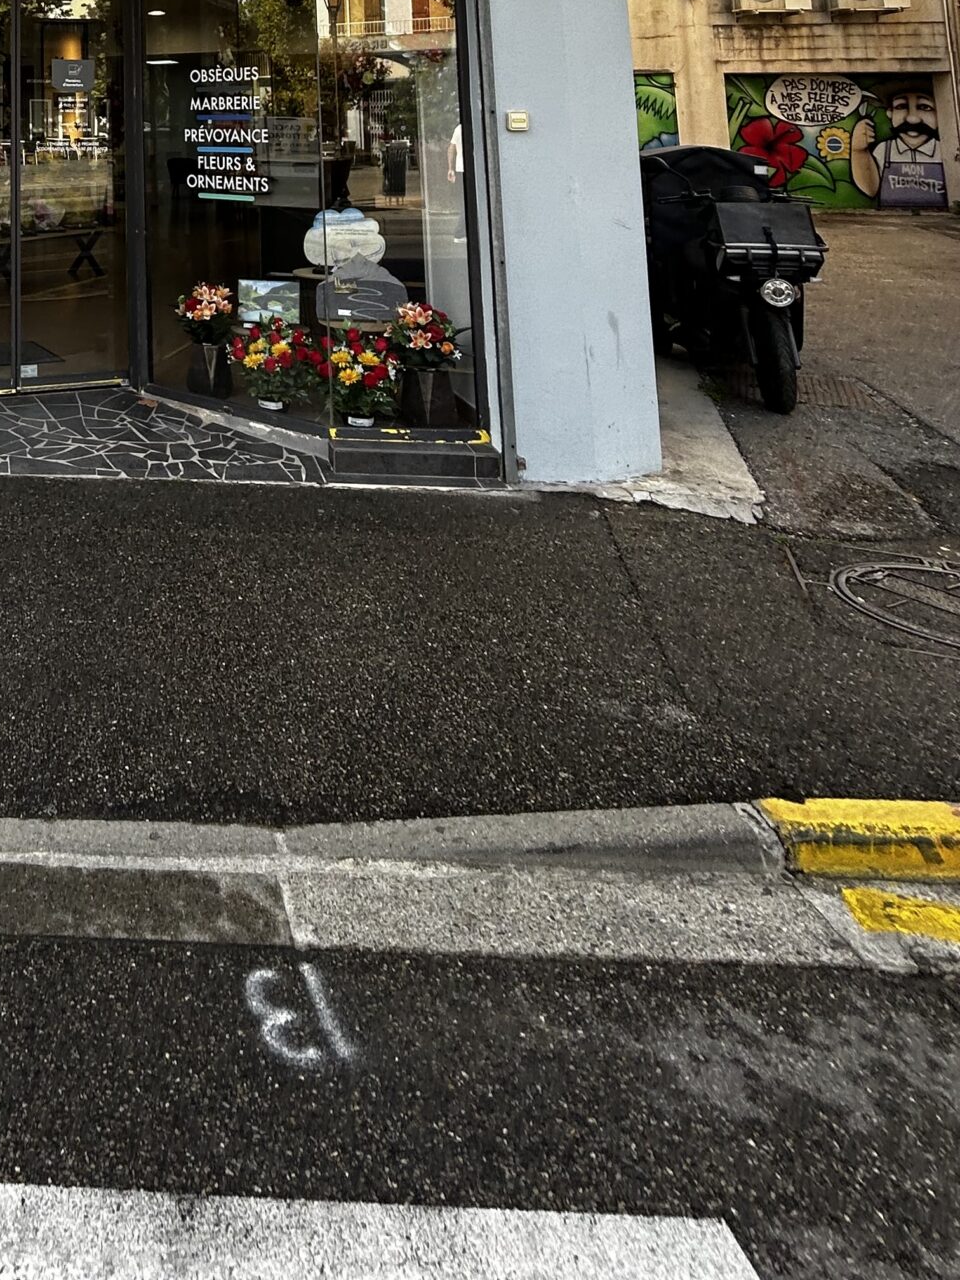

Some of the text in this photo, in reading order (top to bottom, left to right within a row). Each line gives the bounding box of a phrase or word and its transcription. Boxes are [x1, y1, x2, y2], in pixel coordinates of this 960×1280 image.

[190, 65, 259, 83] OBSÈQUES
[783, 79, 807, 91] PAS
[190, 96, 260, 111] MARBRERIE
[781, 92, 802, 102] MES
[808, 92, 851, 107] FLEURS
[778, 103, 840, 113] SVP GAREZ
[184, 125, 269, 143] PRÉVOYANCE
[197, 156, 256, 171] FLEURS &
[901, 164, 925, 176] MON
[186, 174, 269, 192] ORNEMENTS
